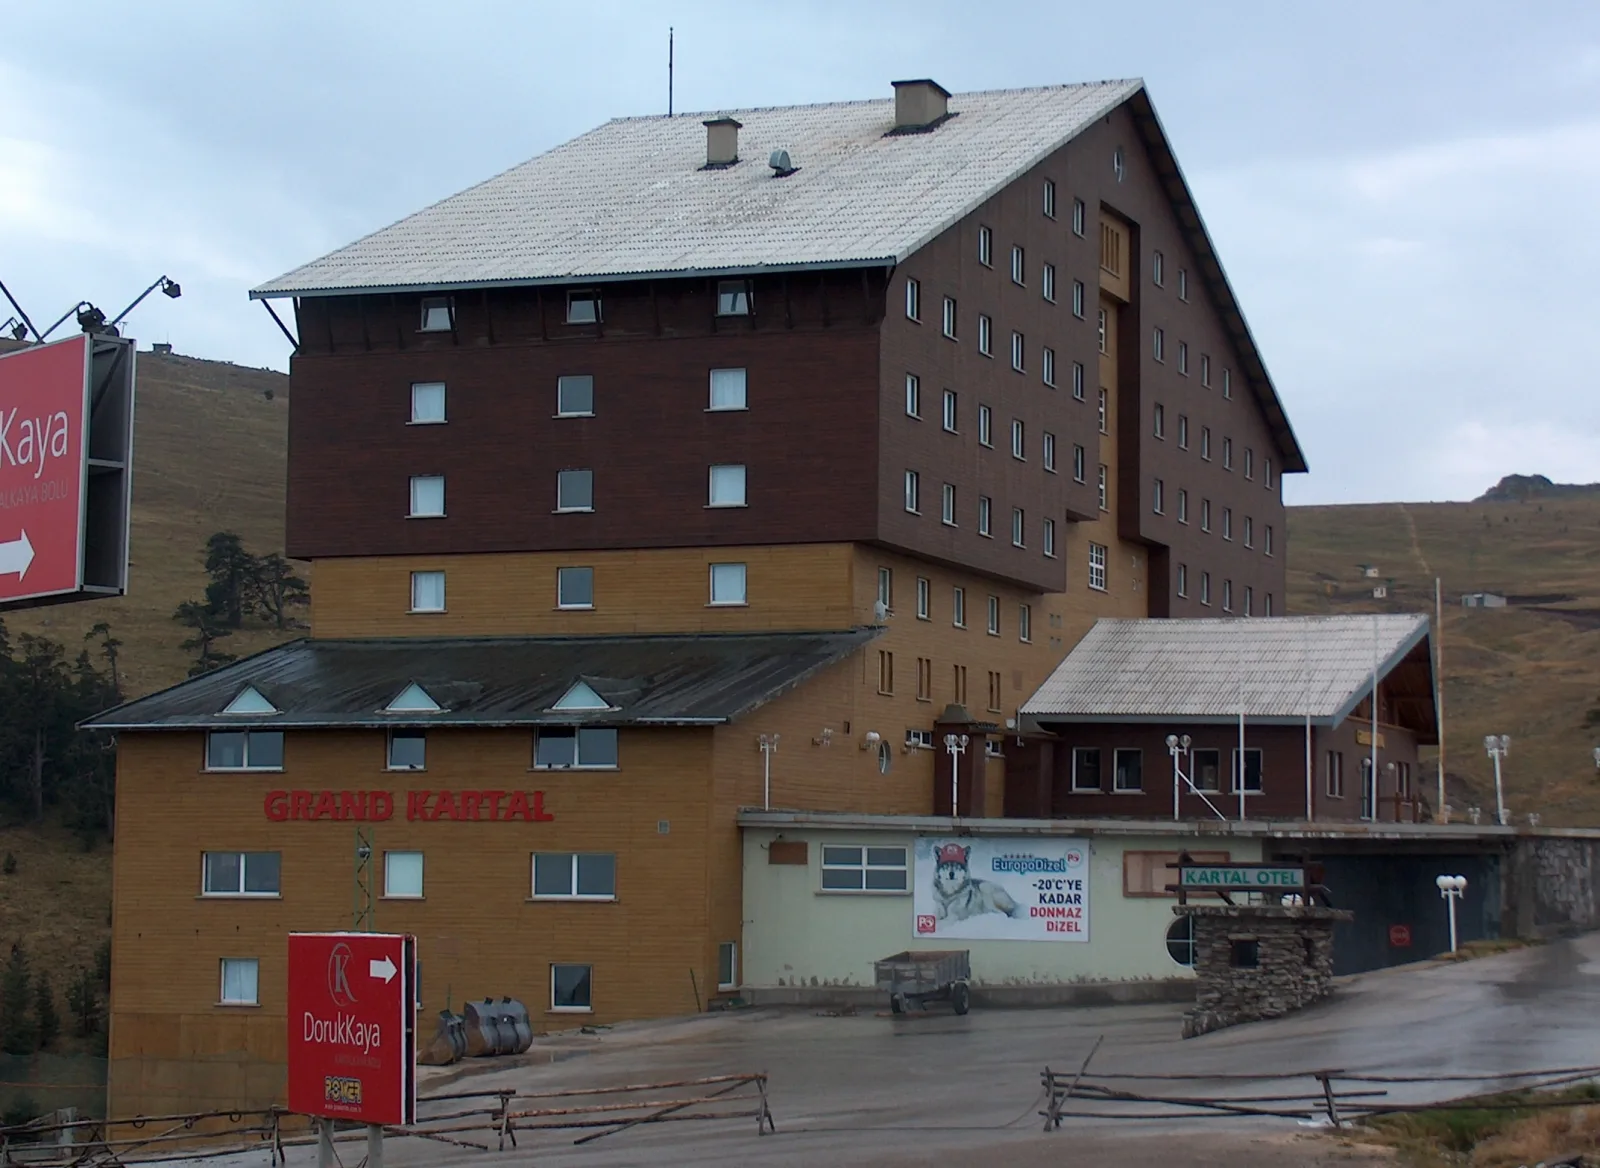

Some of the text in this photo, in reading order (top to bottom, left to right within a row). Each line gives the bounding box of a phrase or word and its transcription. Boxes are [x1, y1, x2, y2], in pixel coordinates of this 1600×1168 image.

[41, 477, 69, 502] BOLU
[264, 790, 554, 822] GRAND KARTAL
[992, 857, 1066, 875] EuropoDizel
[1185, 870, 1298, 884] KARTAL OTEL
[1039, 893, 1082, 904] KADAR
[1030, 907, 1082, 918] DONMAZ
[303, 1011, 380, 1055] DorukKaya
[325, 1076, 362, 1104] POWER
